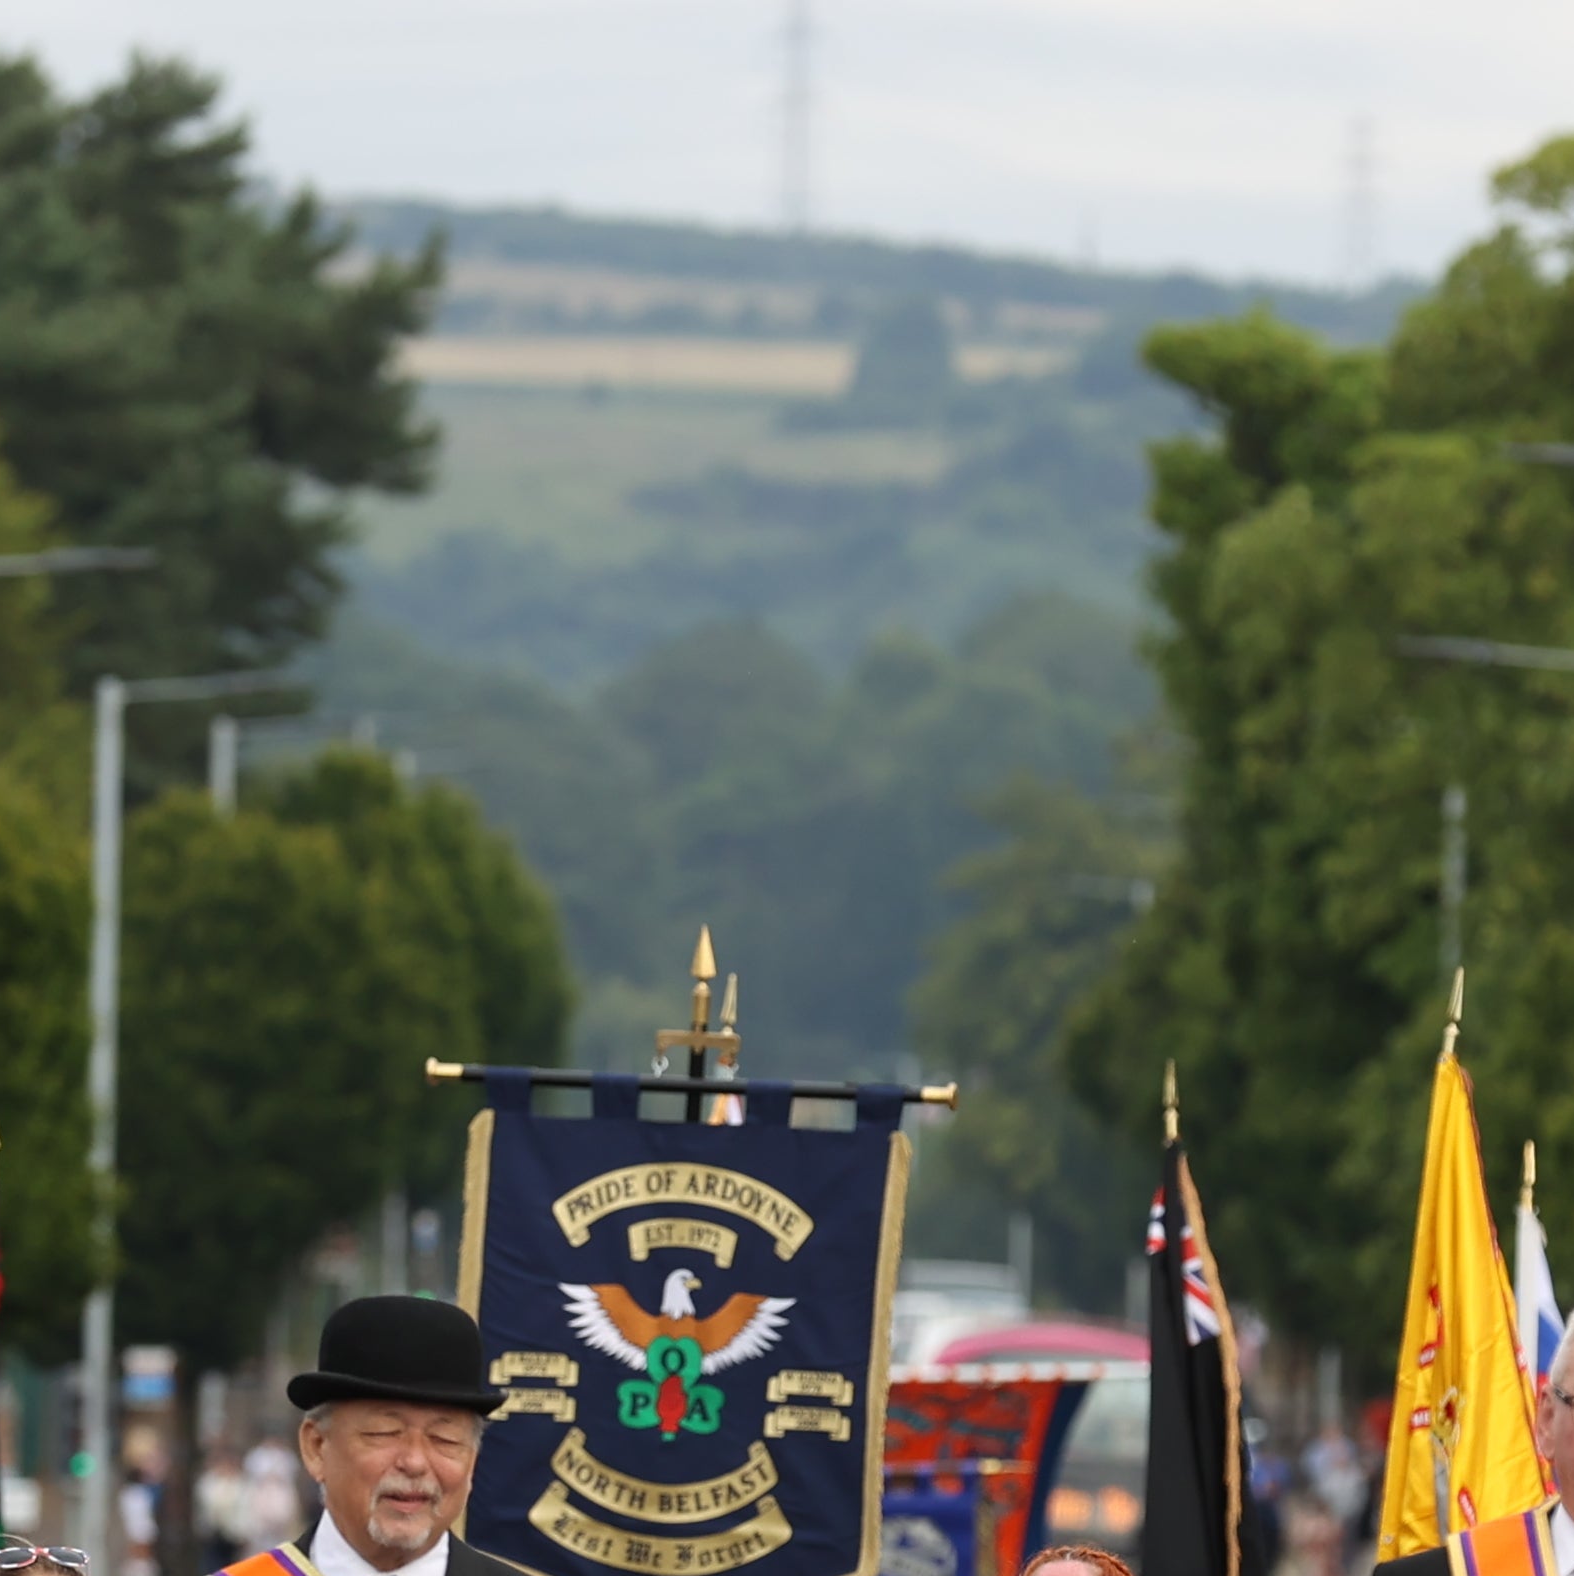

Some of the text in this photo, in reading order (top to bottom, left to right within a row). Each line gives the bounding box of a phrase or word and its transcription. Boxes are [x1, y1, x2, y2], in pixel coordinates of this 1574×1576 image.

[566, 1169, 798, 1236] PRIDE OF ARDOYNE
[660, 1346, 686, 1374] O
[629, 1393, 710, 1422] P A
[557, 1450, 771, 1513] NORTH BELFAST
[552, 1510, 767, 1570] Lest We Forget
